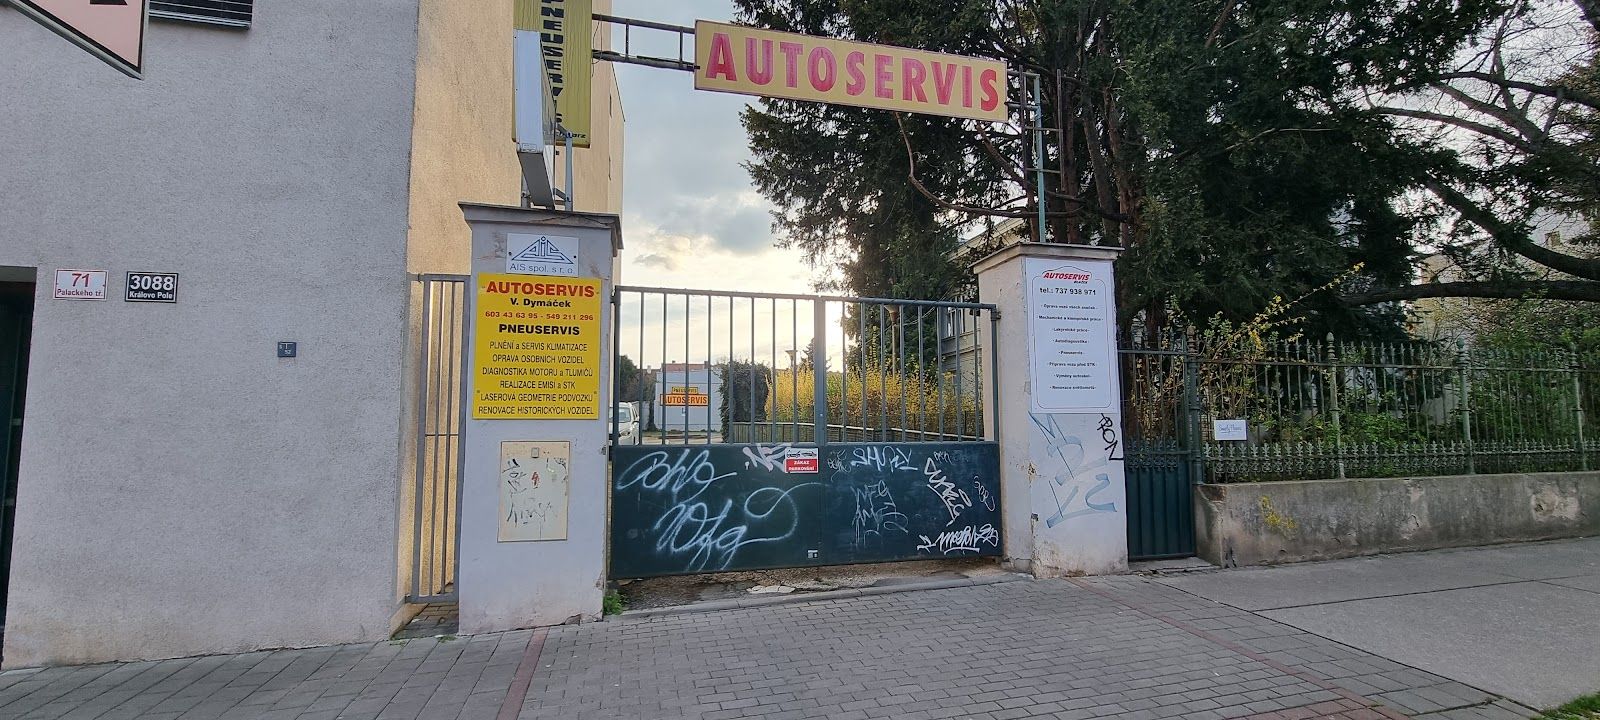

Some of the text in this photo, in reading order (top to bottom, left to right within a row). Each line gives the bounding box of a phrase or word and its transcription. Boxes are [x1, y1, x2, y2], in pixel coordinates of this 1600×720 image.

[705, 32, 999, 112] AUTOSERVIS
[510, 263, 526, 271] AIS
[528, 264, 548, 273] spol.
[72, 273, 90, 288] 71
[1044, 272, 1090, 280] AUTOSERVIS
[130, 275, 174, 290] 3088
[129, 290, 156, 298] Královo
[486, 281, 594, 298] AUTOSERVIS
[510, 298, 571, 308] V. Dymáček
[498, 324, 580, 336] PNEUSERVIS
[522, 342, 545, 350] SERVIS
[546, 343, 588, 352] KLIMATIZACE
[492, 354, 520, 362] OPRAVA
[558, 356, 584, 364] VOZIDEL
[482, 367, 528, 376] DIAGNOSTIKA
[530, 368, 558, 376] MOTORU
[500, 380, 536, 388] REALIZACE
[563, 381, 576, 389] STK
[518, 394, 556, 402] GEOMETRIE
[558, 394, 593, 402] PODVOZKU
[478, 405, 594, 415] RENOVACE HISTORICKÝCH VOZIDEL
